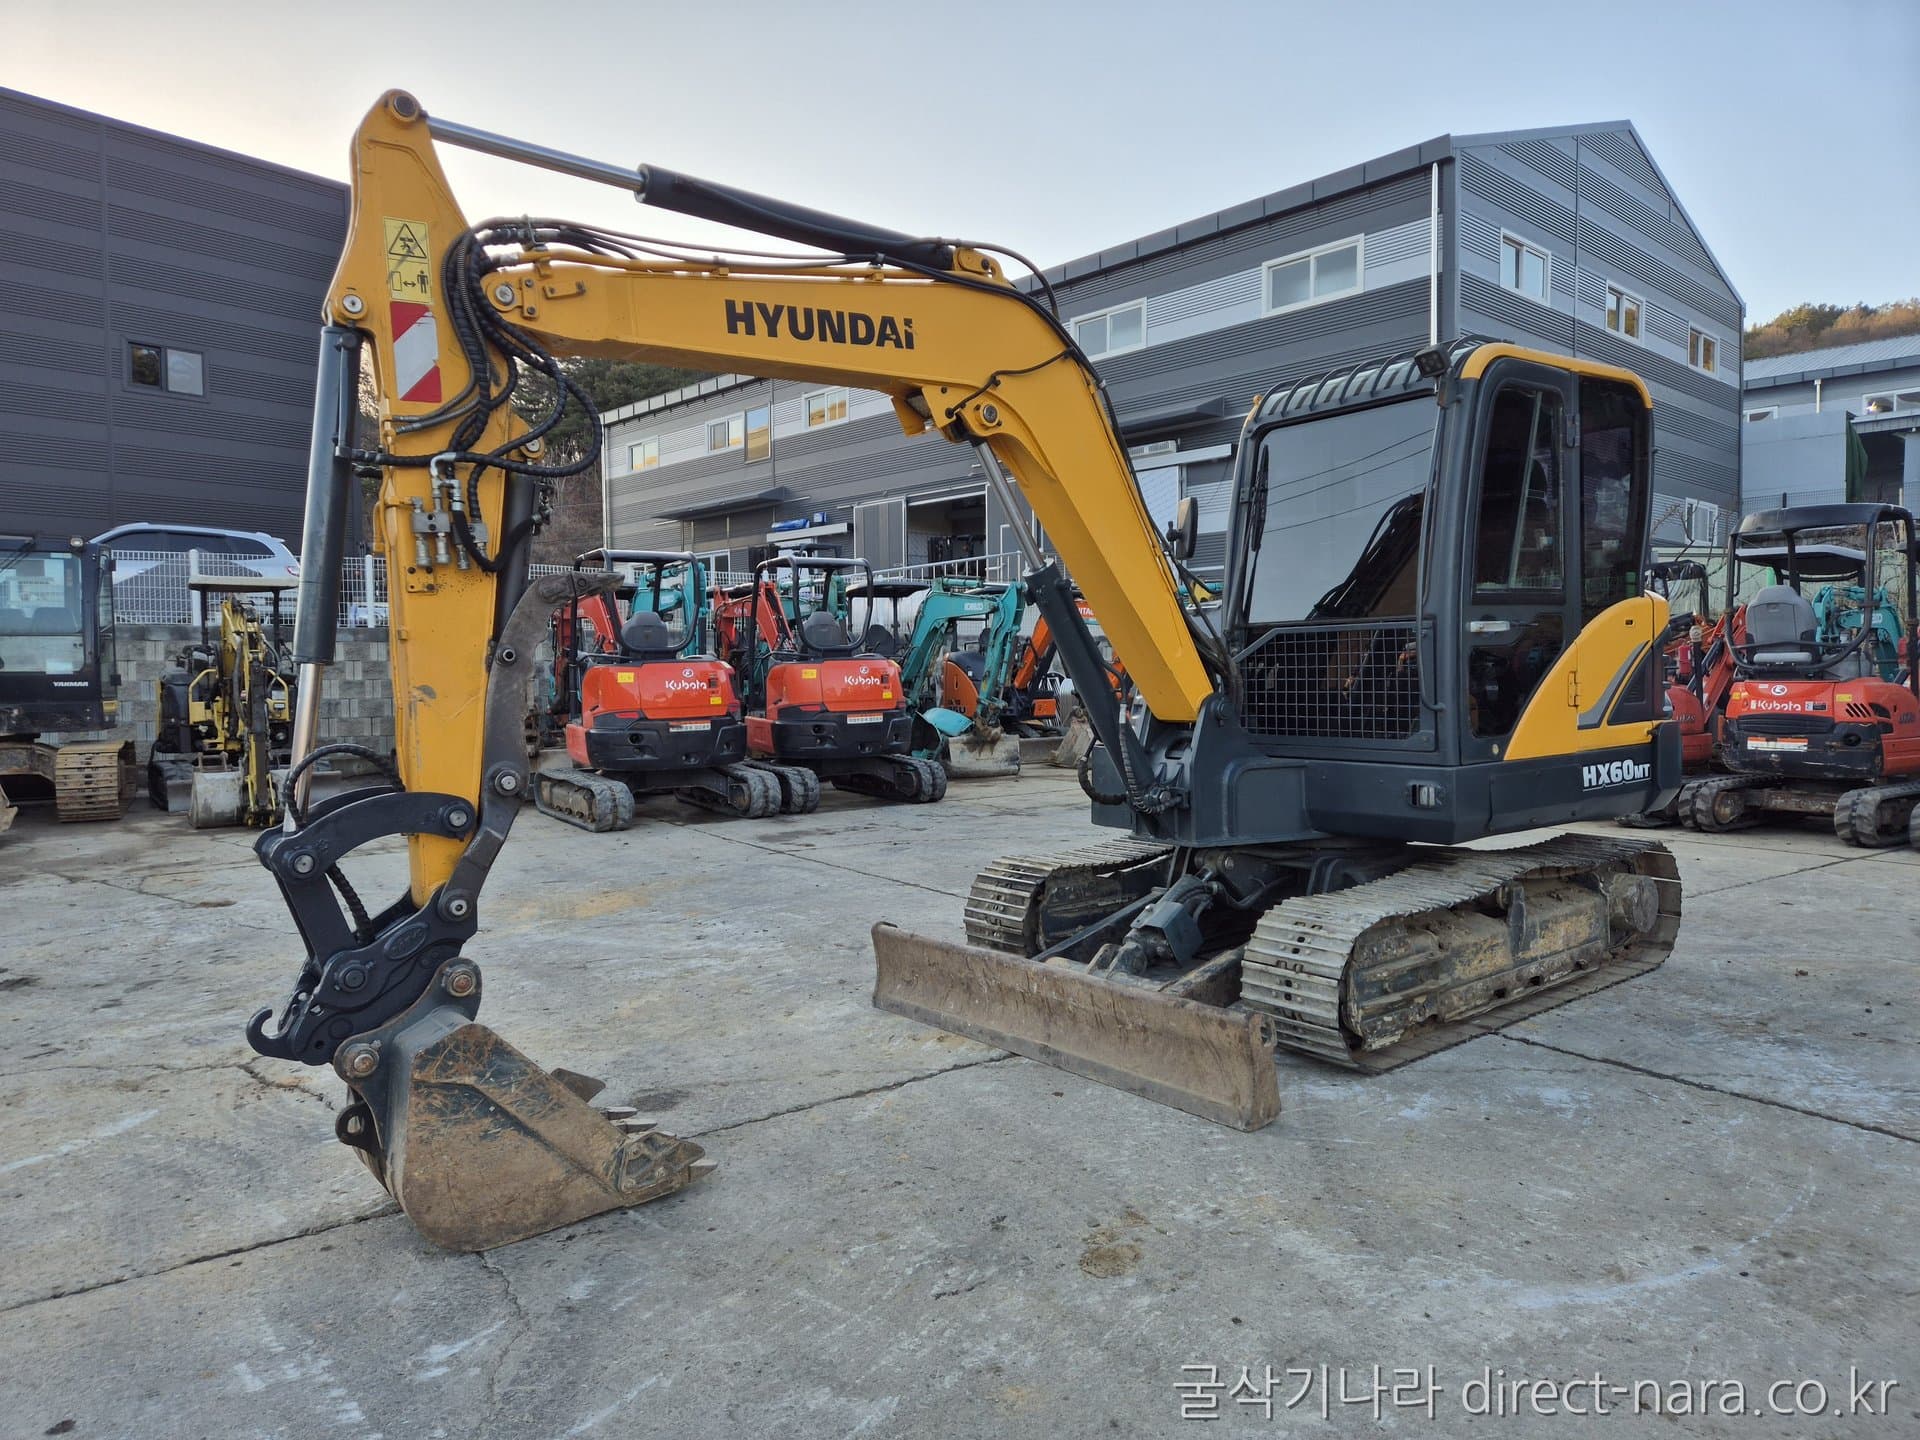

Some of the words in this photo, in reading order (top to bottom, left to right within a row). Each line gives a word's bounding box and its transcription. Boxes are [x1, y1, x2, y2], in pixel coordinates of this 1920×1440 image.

[725, 299, 915, 350] HYUNDAI
[665, 680, 708, 690] Kubota
[844, 675, 881, 685] Kubota
[1757, 700, 1802, 712] Kubota
[1582, 759, 1651, 788] HX60MT
